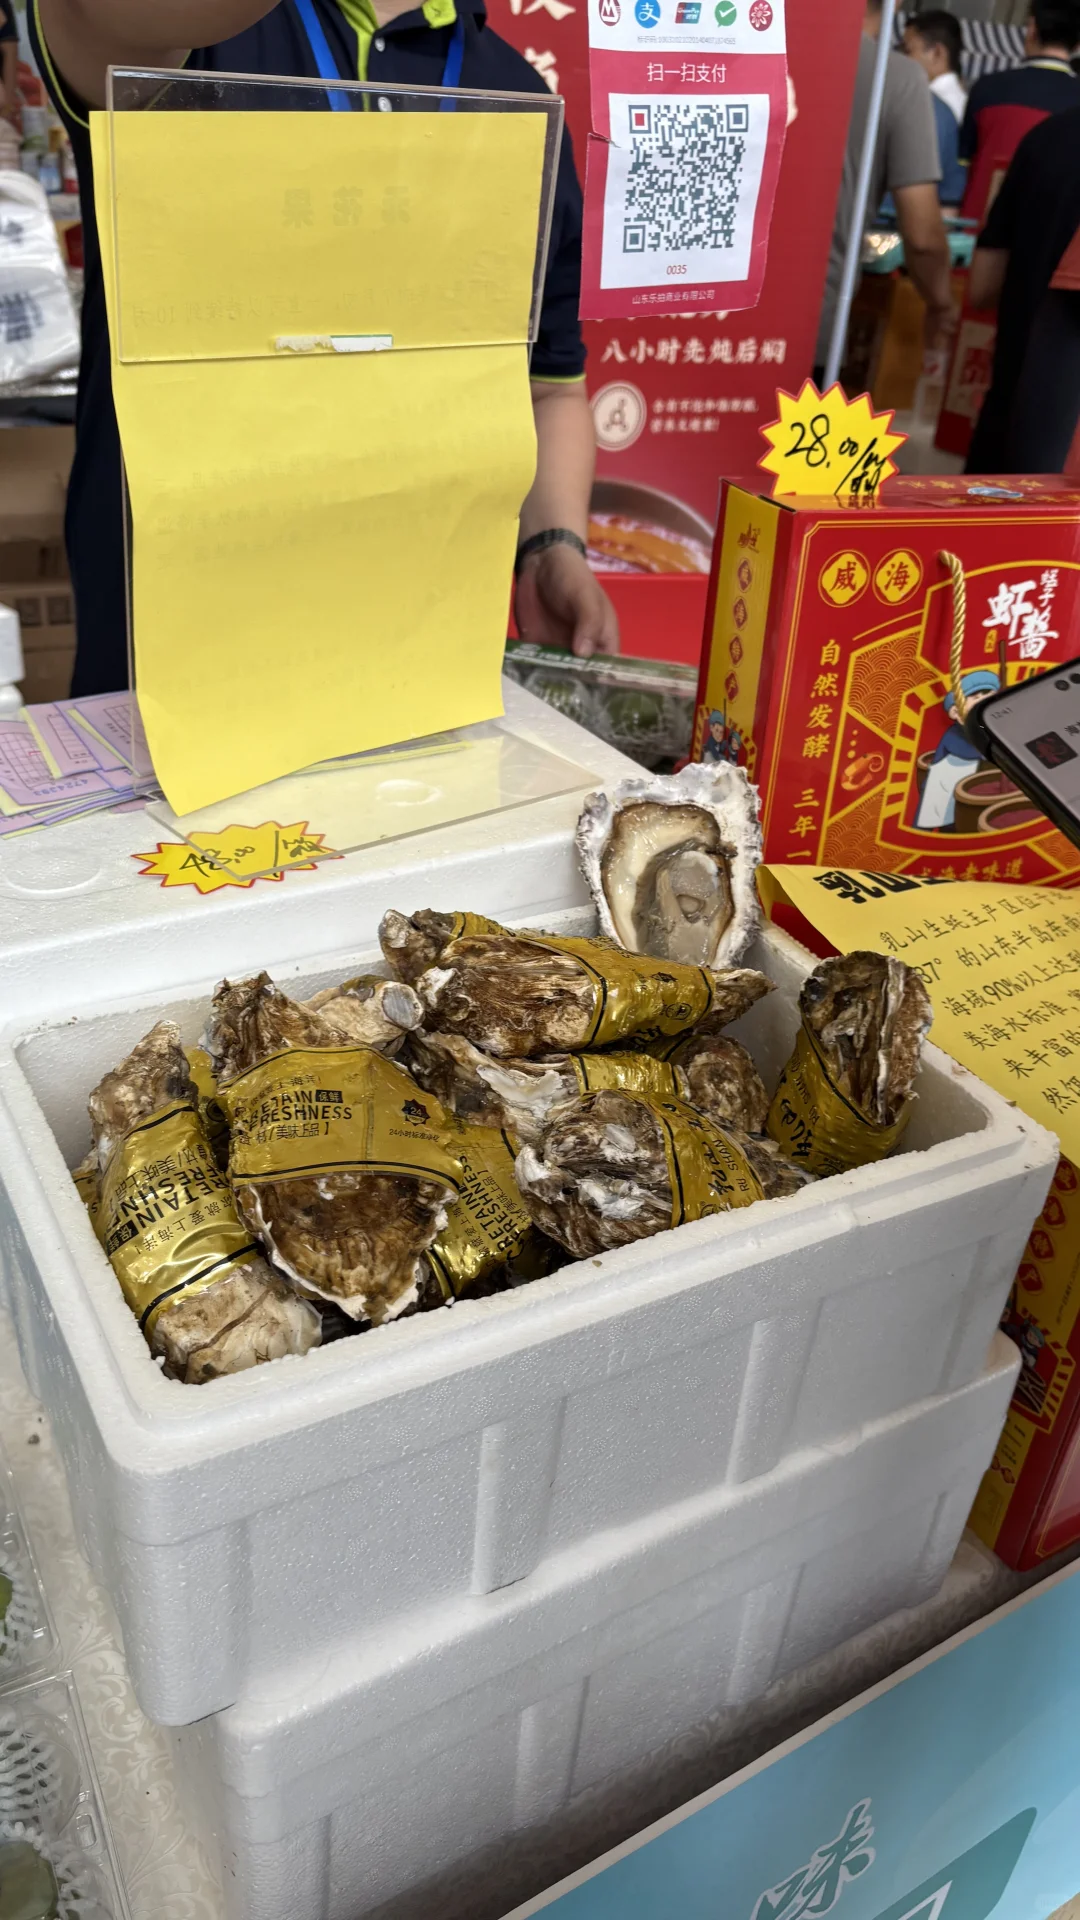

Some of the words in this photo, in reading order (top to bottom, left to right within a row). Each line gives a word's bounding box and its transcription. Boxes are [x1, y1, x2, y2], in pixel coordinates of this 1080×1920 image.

[646, 62, 727, 84] 扫一扫支付
[666, 264, 688, 275] 0035
[600, 336, 788, 366] 八小时先炖后焖
[829, 560, 911, 593] 威海
[802, 639, 842, 760] 自然发酵
[249, 1104, 353, 1132] FRESHNESS
[713, 1139, 740, 1171] SHAN
[135, 1178, 232, 1230] RETAIN
[462, 1190, 515, 1252] RETAIN
